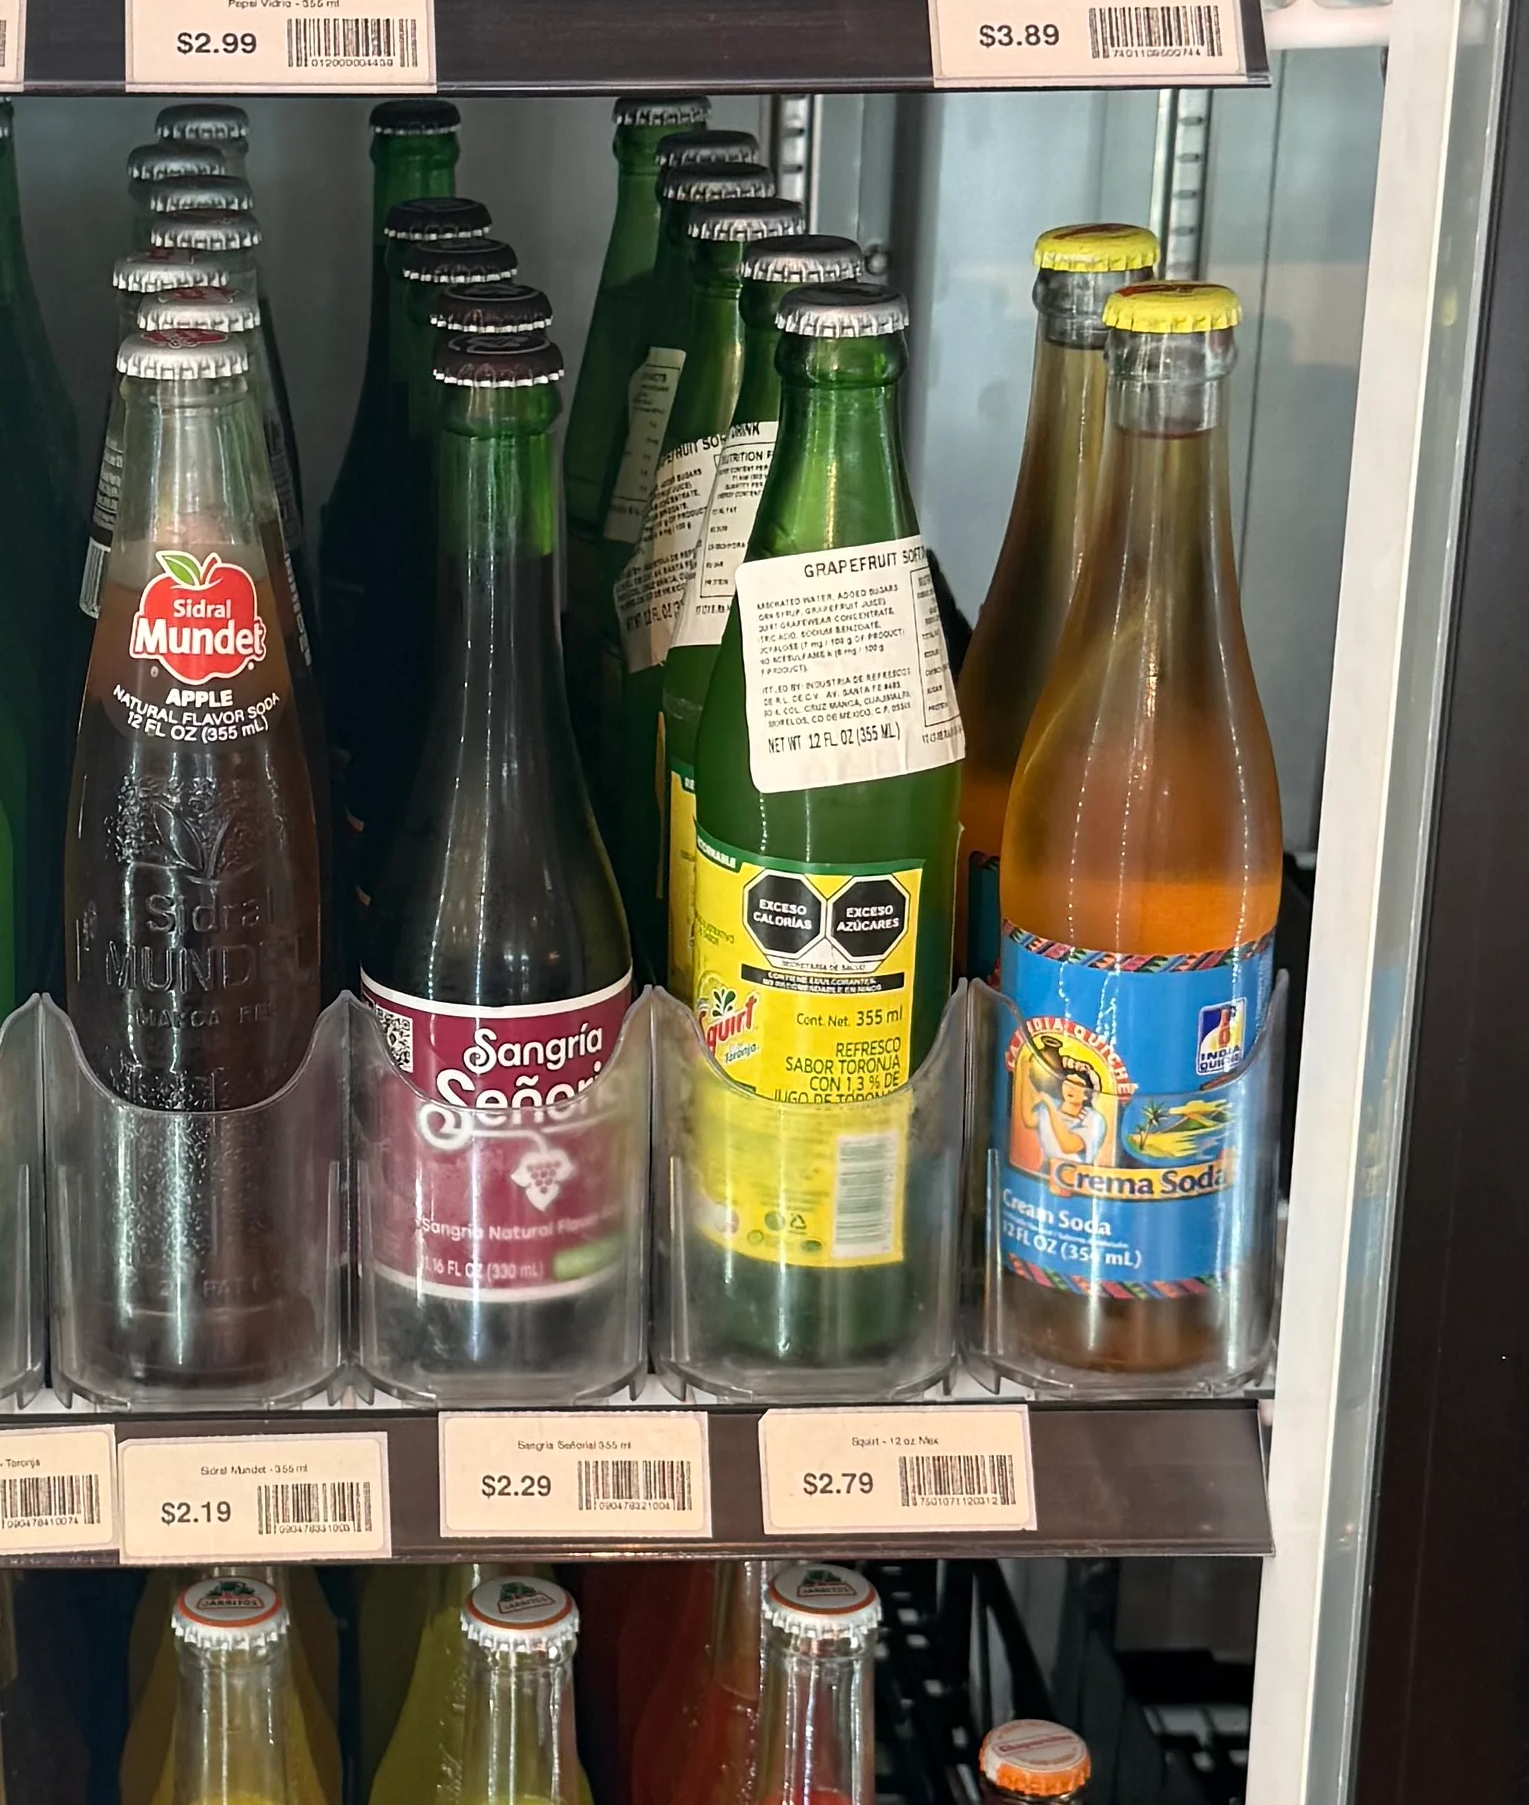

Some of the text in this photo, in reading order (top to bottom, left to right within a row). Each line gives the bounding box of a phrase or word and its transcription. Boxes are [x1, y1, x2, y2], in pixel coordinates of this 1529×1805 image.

[176, 31, 258, 56] $2.99
[979, 24, 1060, 48] $3.89
[804, 552, 898, 579] GRAPEFRUIT
[172, 598, 232, 619] Sidral
[134, 617, 265, 656] Mundet
[113, 684, 281, 727] NATURAL FLAVOR SODA
[165, 688, 234, 709] APPLE
[127, 711, 270, 744] 12 FL OZ (355 mL)
[767, 725, 879, 754] NET 12 OZ (355
[759, 898, 807, 916] EXCESO
[846, 904, 894, 919] EXCESO
[752, 911, 813, 932] CALORÍAS
[836, 914, 900, 933] AZÚCARES
[796, 1004, 903, 1027] Cont. 355 ml
[463, 1022, 604, 1075] Sangría
[835, 1036, 901, 1058] REFRESCO
[785, 1054, 902, 1074] SABOR TORONJA
[810, 1071, 900, 1092] CON DE
[1054, 1163, 1153, 1196] Crema
[1003, 1188, 1112, 1237] Cream Soda
[488, 1222, 554, 1242] Natural
[1105, 1248, 1142, 1270] mL)
[481, 1473, 552, 1499] $2.29
[803, 1471, 874, 1496] $2.79
[161, 1500, 232, 1526] $2.19
